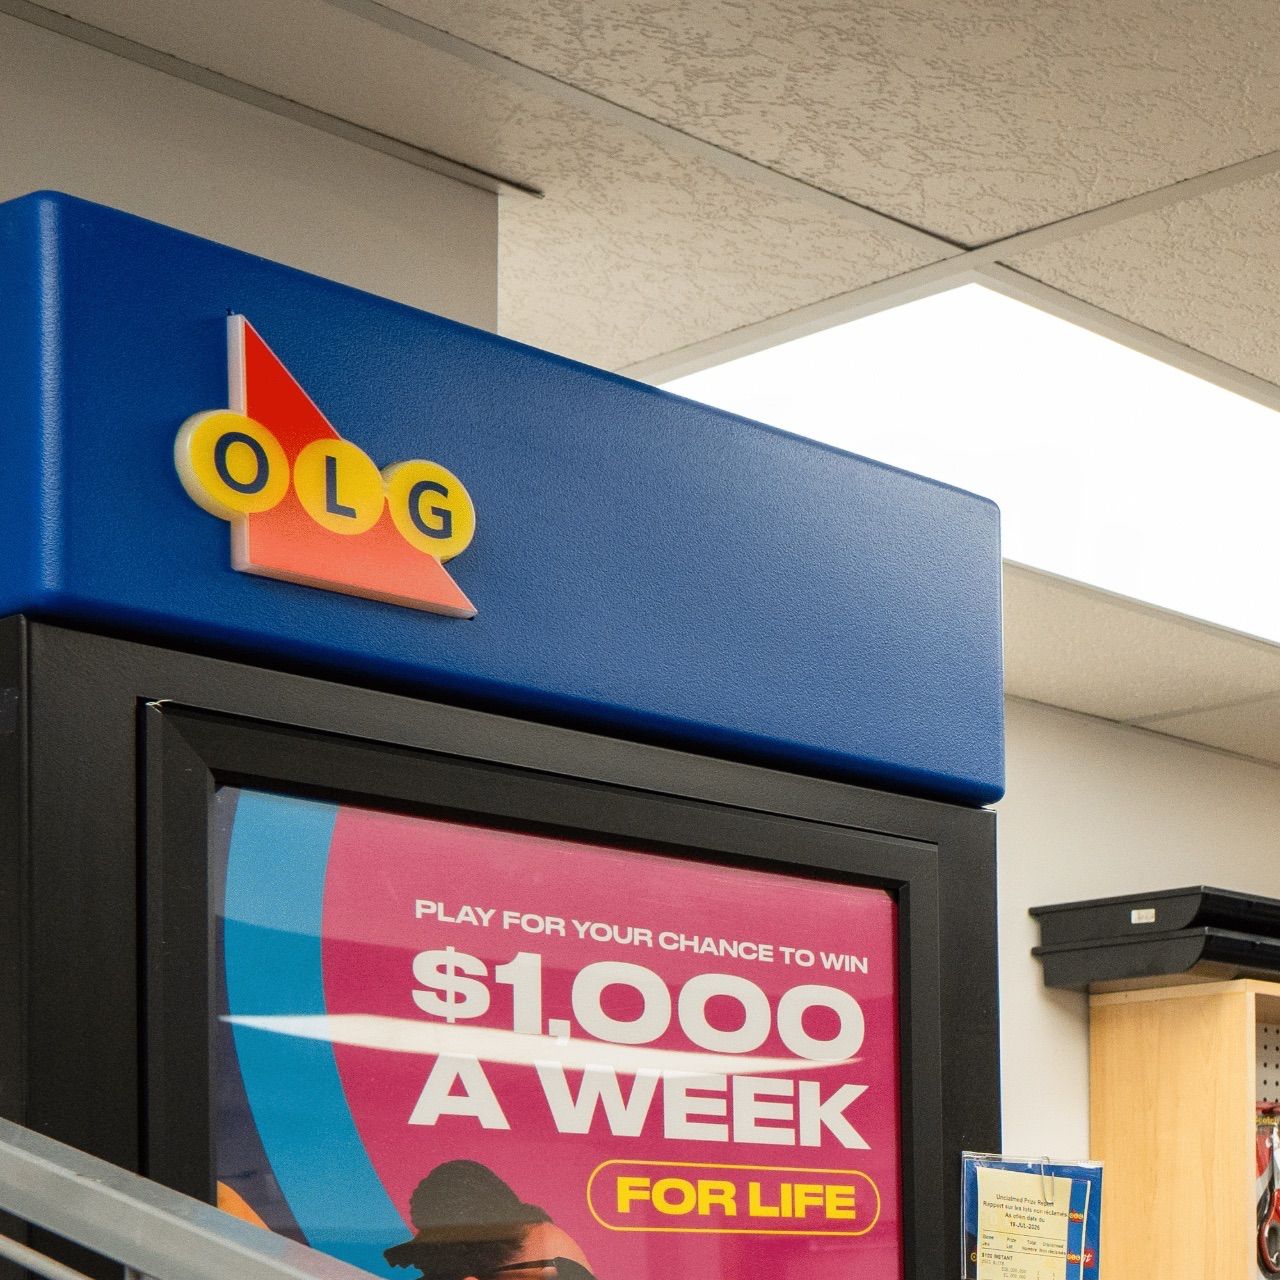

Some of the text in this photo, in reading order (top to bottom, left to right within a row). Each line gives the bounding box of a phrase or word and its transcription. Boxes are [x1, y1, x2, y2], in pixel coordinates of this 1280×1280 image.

[212, 431, 453, 539] OLG
[415, 899, 868, 974] PLAY FOR YOUR CHANCE TO WIN
[411, 946, 865, 1061] $1,000
[407, 1051, 871, 1150] A WEEK
[616, 1177, 856, 1220] FOR LIFE
